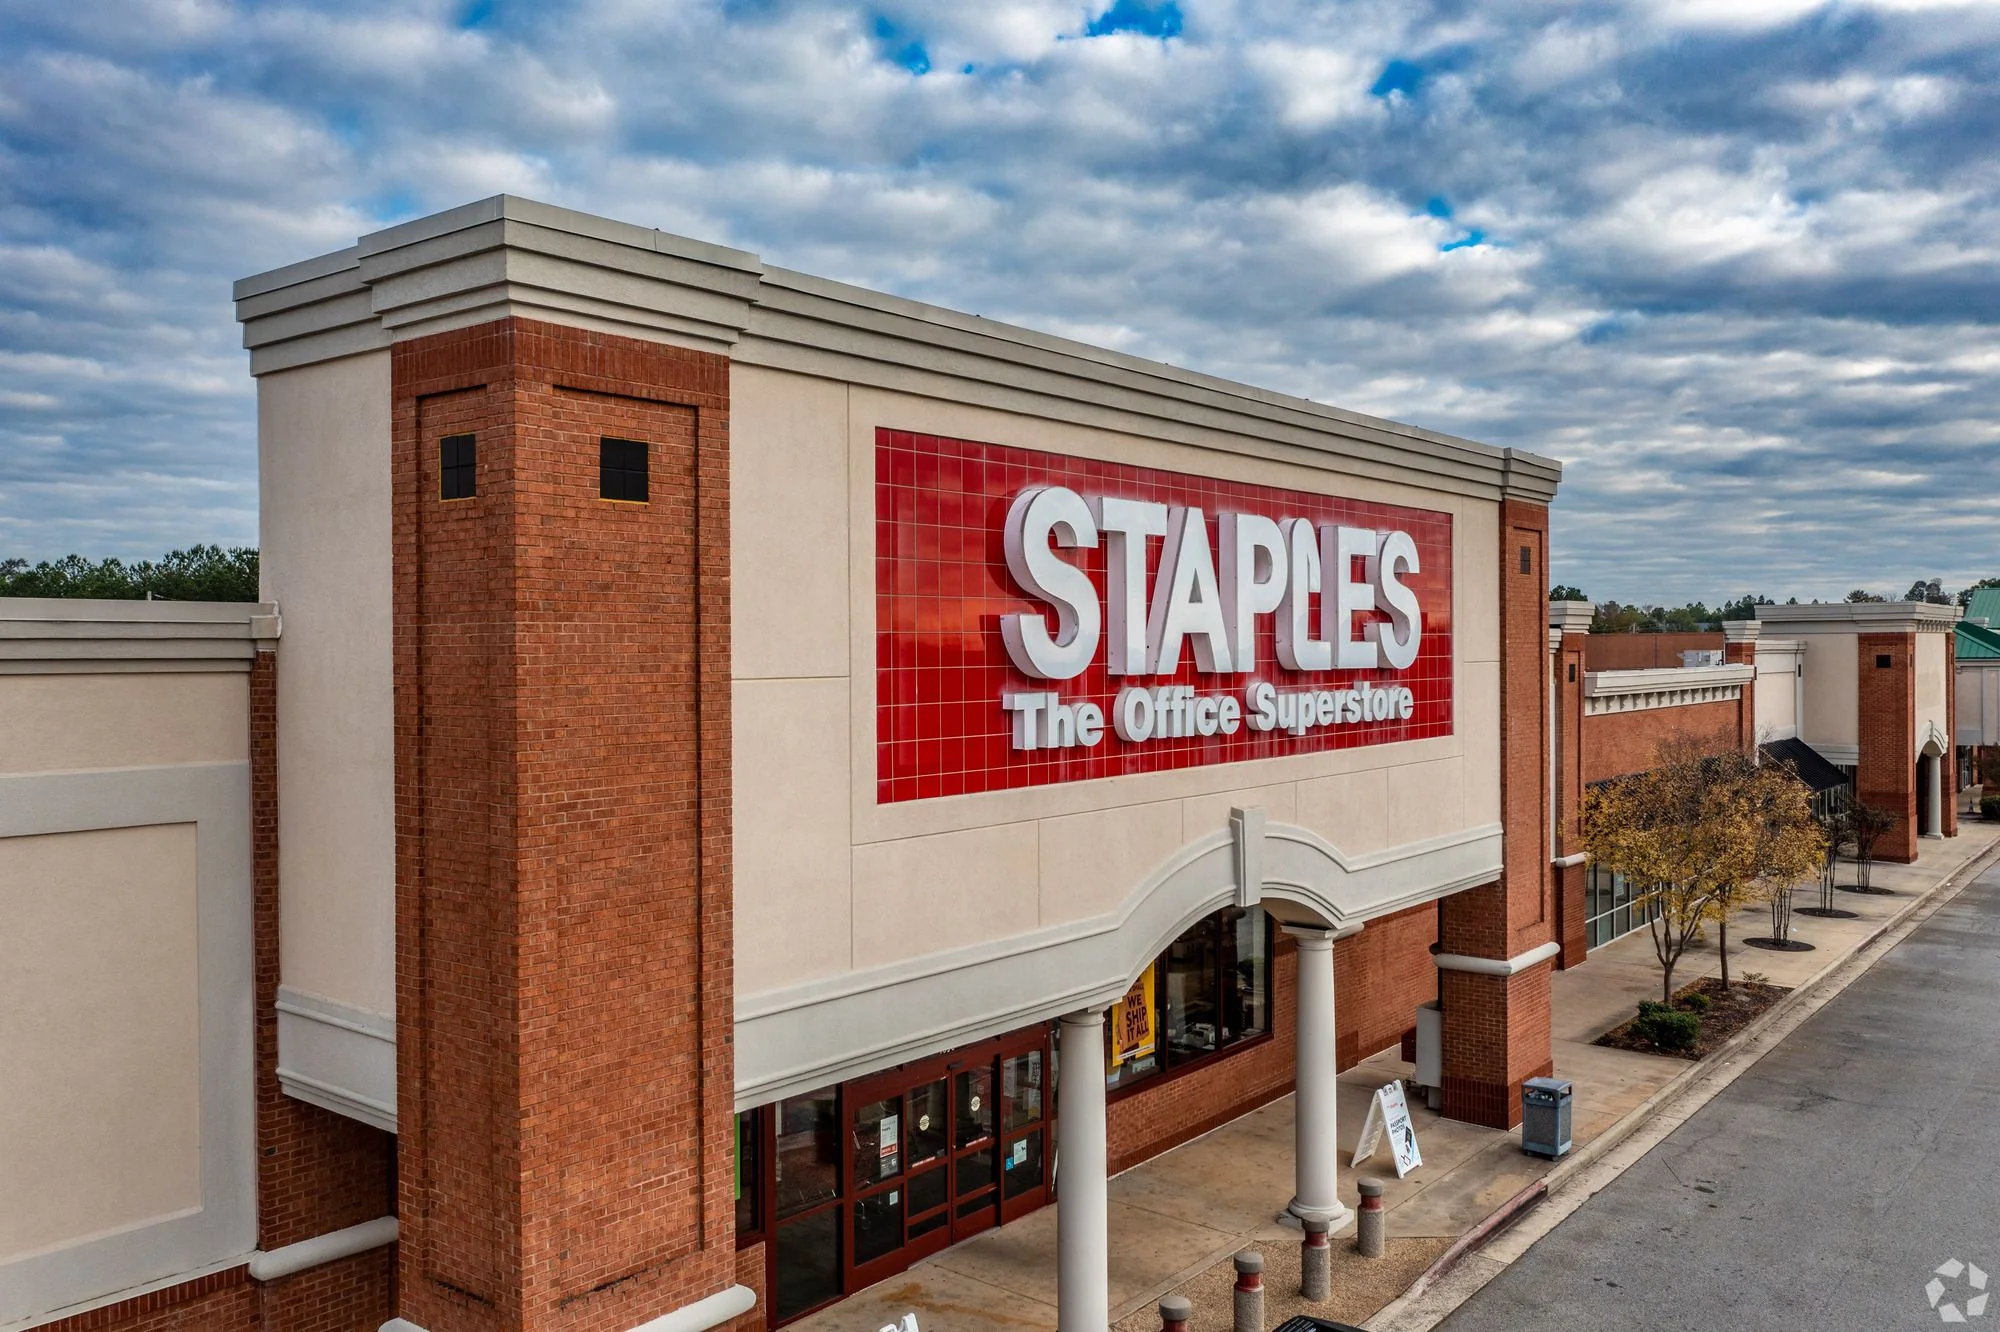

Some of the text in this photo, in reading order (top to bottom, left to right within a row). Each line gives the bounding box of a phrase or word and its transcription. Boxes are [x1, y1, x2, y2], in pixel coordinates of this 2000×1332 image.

[1001, 486, 1421, 679] STAPLES
[1003, 681, 1414, 750] The Office Superstore
[1127, 994, 1142, 1008] WE
[1126, 1006, 1147, 1028] SHIP
[1127, 1020, 1149, 1042] IT ALL
